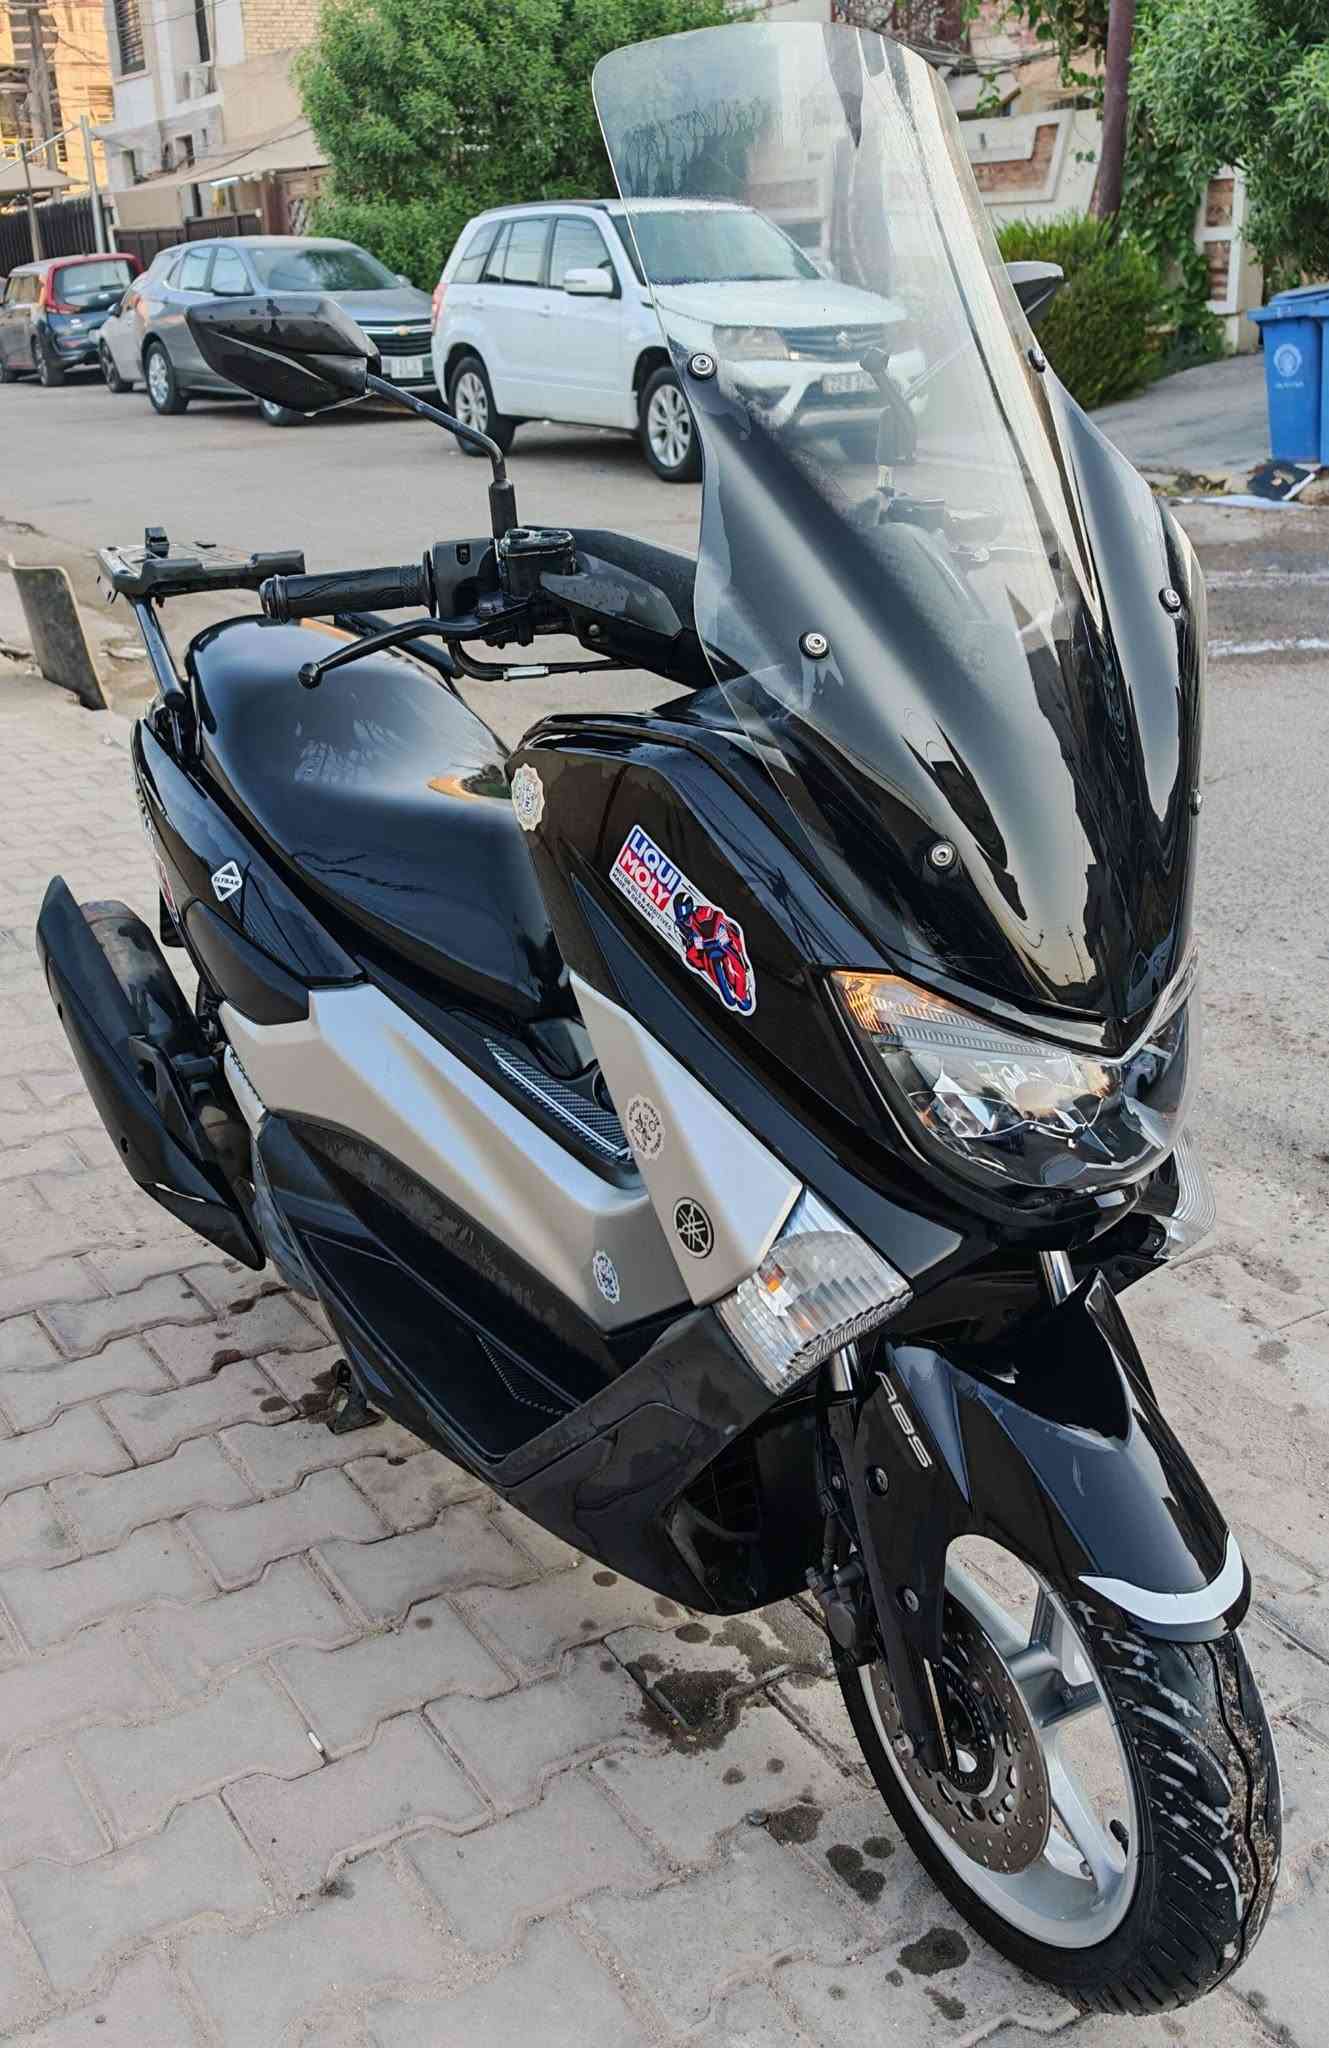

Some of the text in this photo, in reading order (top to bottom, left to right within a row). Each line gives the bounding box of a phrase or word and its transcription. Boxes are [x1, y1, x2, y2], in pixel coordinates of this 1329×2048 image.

[614, 867, 631, 885] MOTOR
[620, 848, 671, 905] MOLY
[630, 831, 679, 891] LIQUI
[611, 872, 625, 887] MADE
[629, 893, 655, 920] GERMANY
[875, 1371, 933, 1468] ABS
